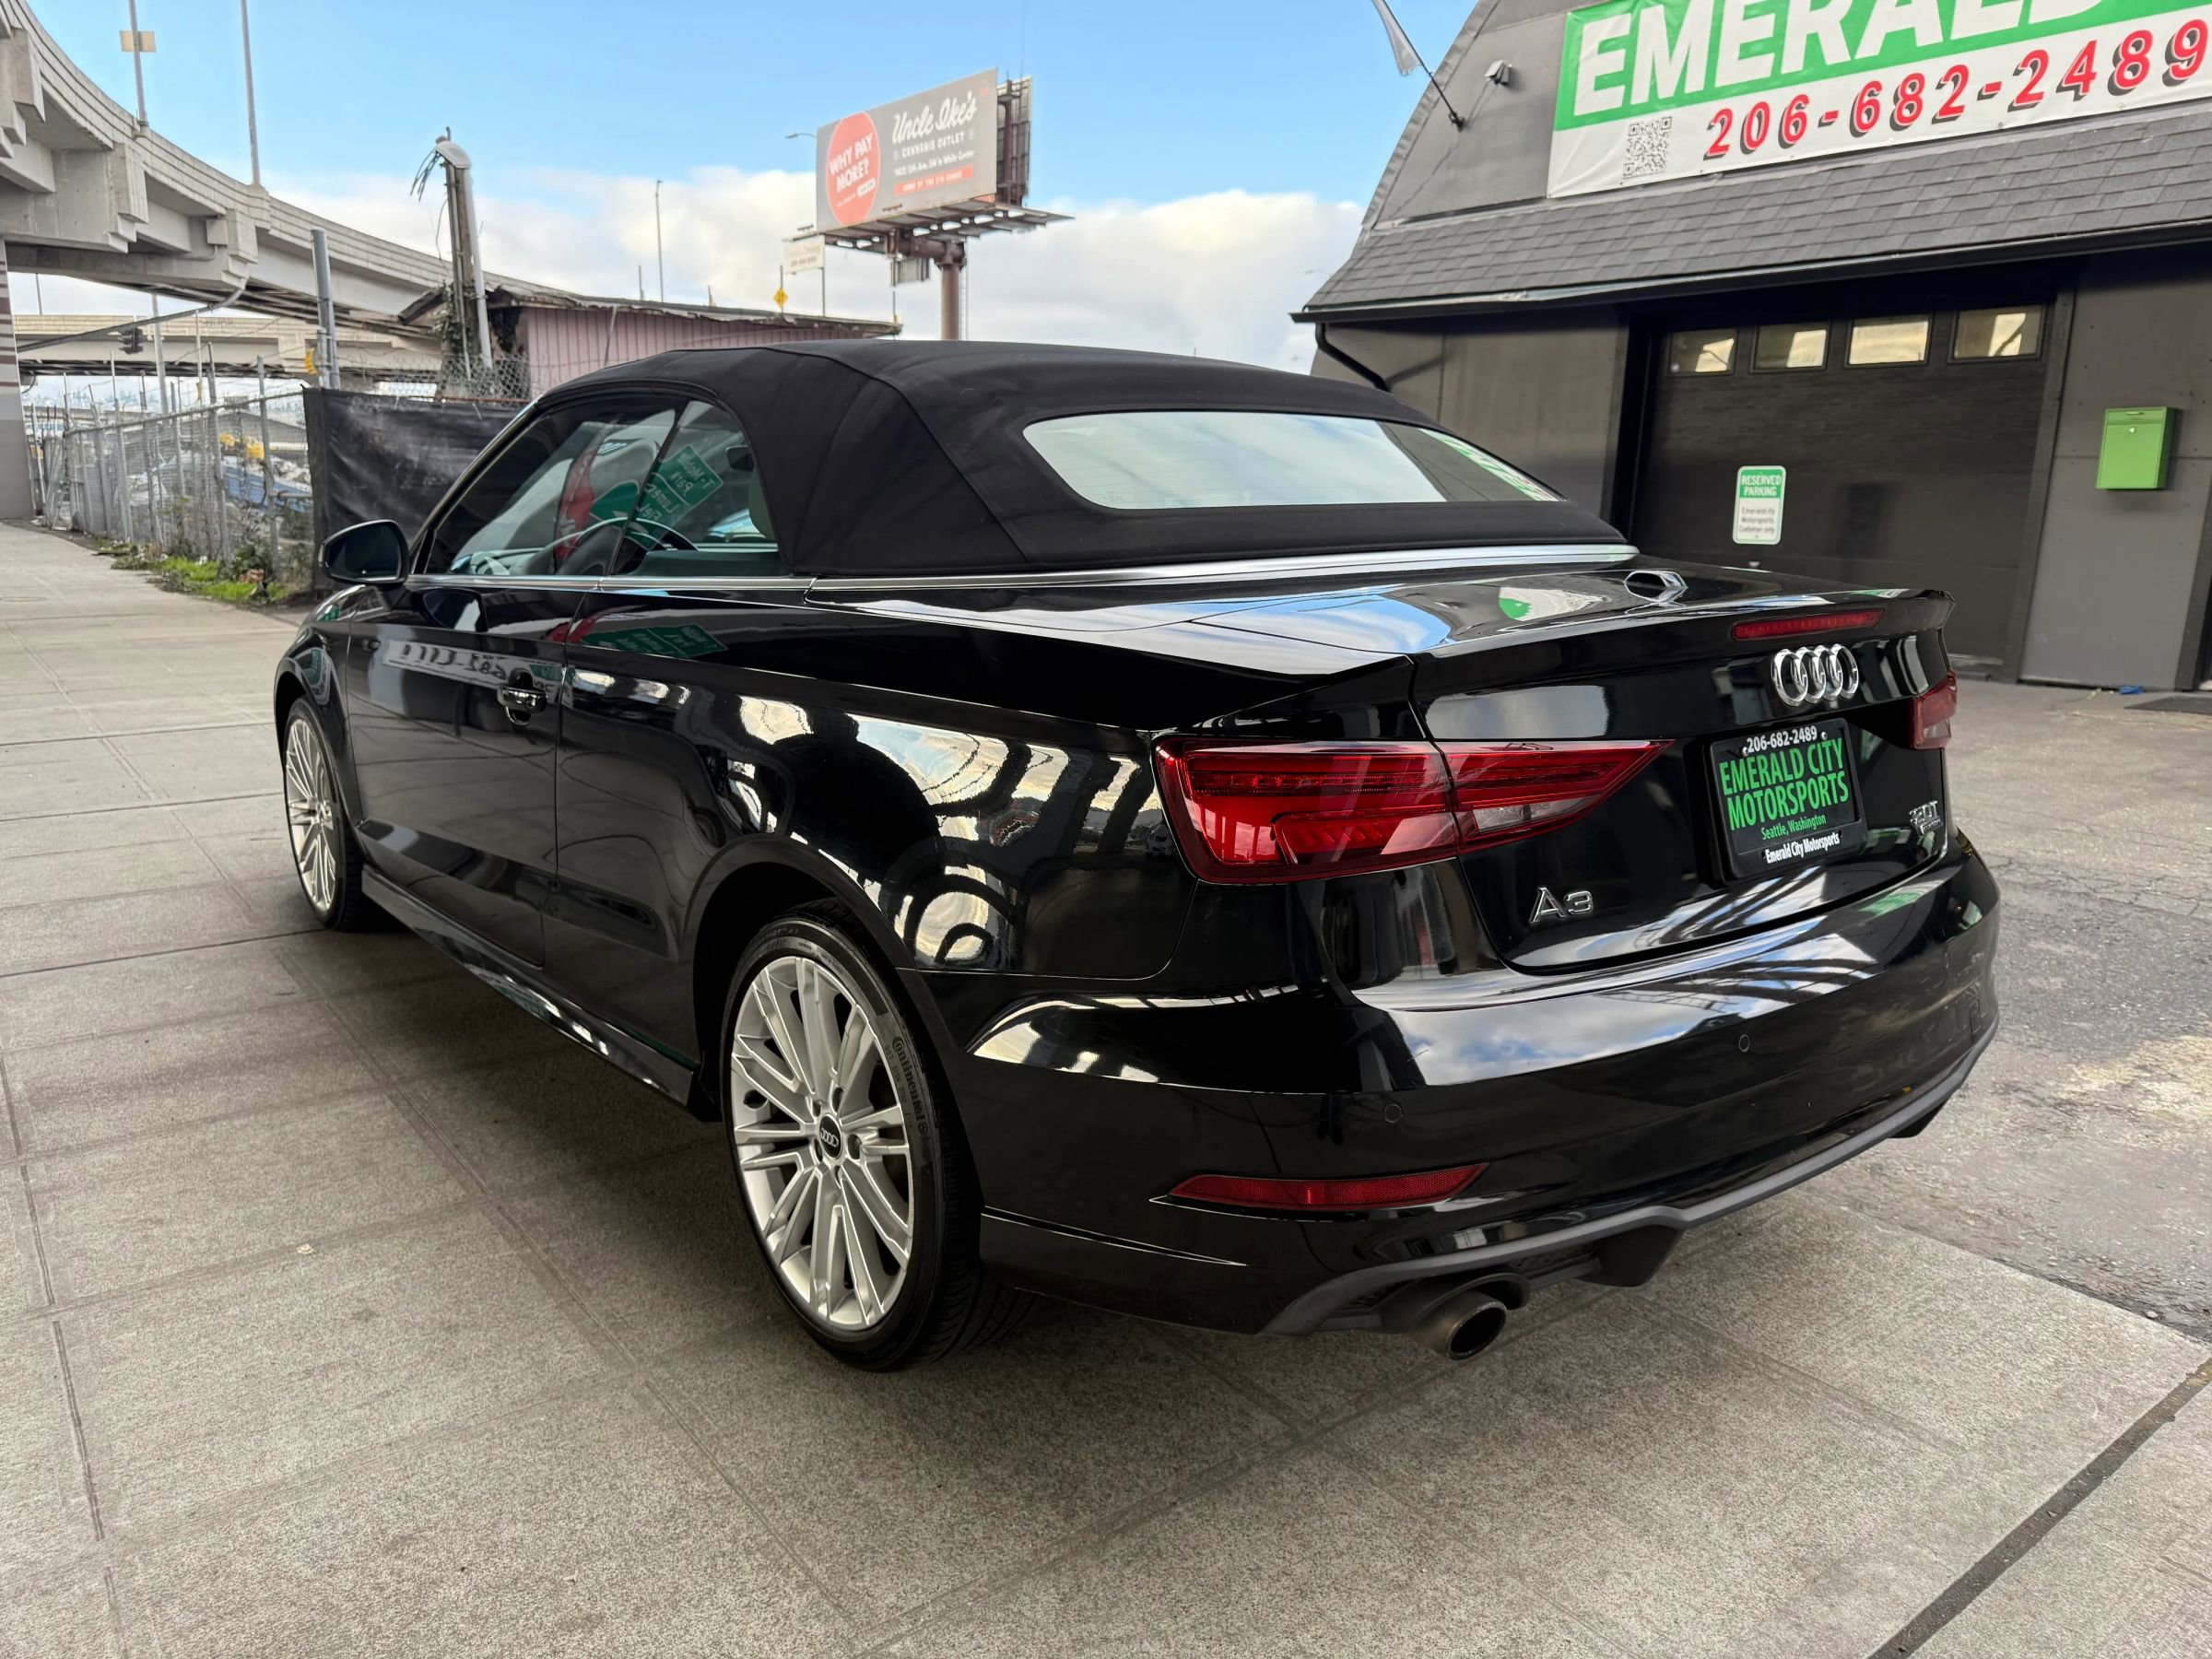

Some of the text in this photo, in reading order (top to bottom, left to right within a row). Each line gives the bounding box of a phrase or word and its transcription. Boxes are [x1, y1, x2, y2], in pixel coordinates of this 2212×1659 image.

[1573, 0, 2105, 116] EMERA
[1705, 19, 2209, 159] 206-682-2489
[891, 90, 978, 145] Uncle Ike's
[830, 132, 874, 176] WHY PAY
[936, 131, 965, 149] OUTLET
[836, 157, 870, 194] MORE?
[1741, 475, 1782, 487] RESERVED
[1743, 486, 1777, 497] PARKING
[1747, 725, 1818, 753] 206-682-2489
[1719, 737, 1844, 795] EMERALD CITY
[1727, 771, 1849, 830] MOTORSPORTS
[1760, 814, 1827, 840] Seattle, Washington
[1765, 830, 1840, 865] Emerald City Motorsports
[1529, 887, 1594, 924] A3
[892, 1036, 926, 1122] Continental
